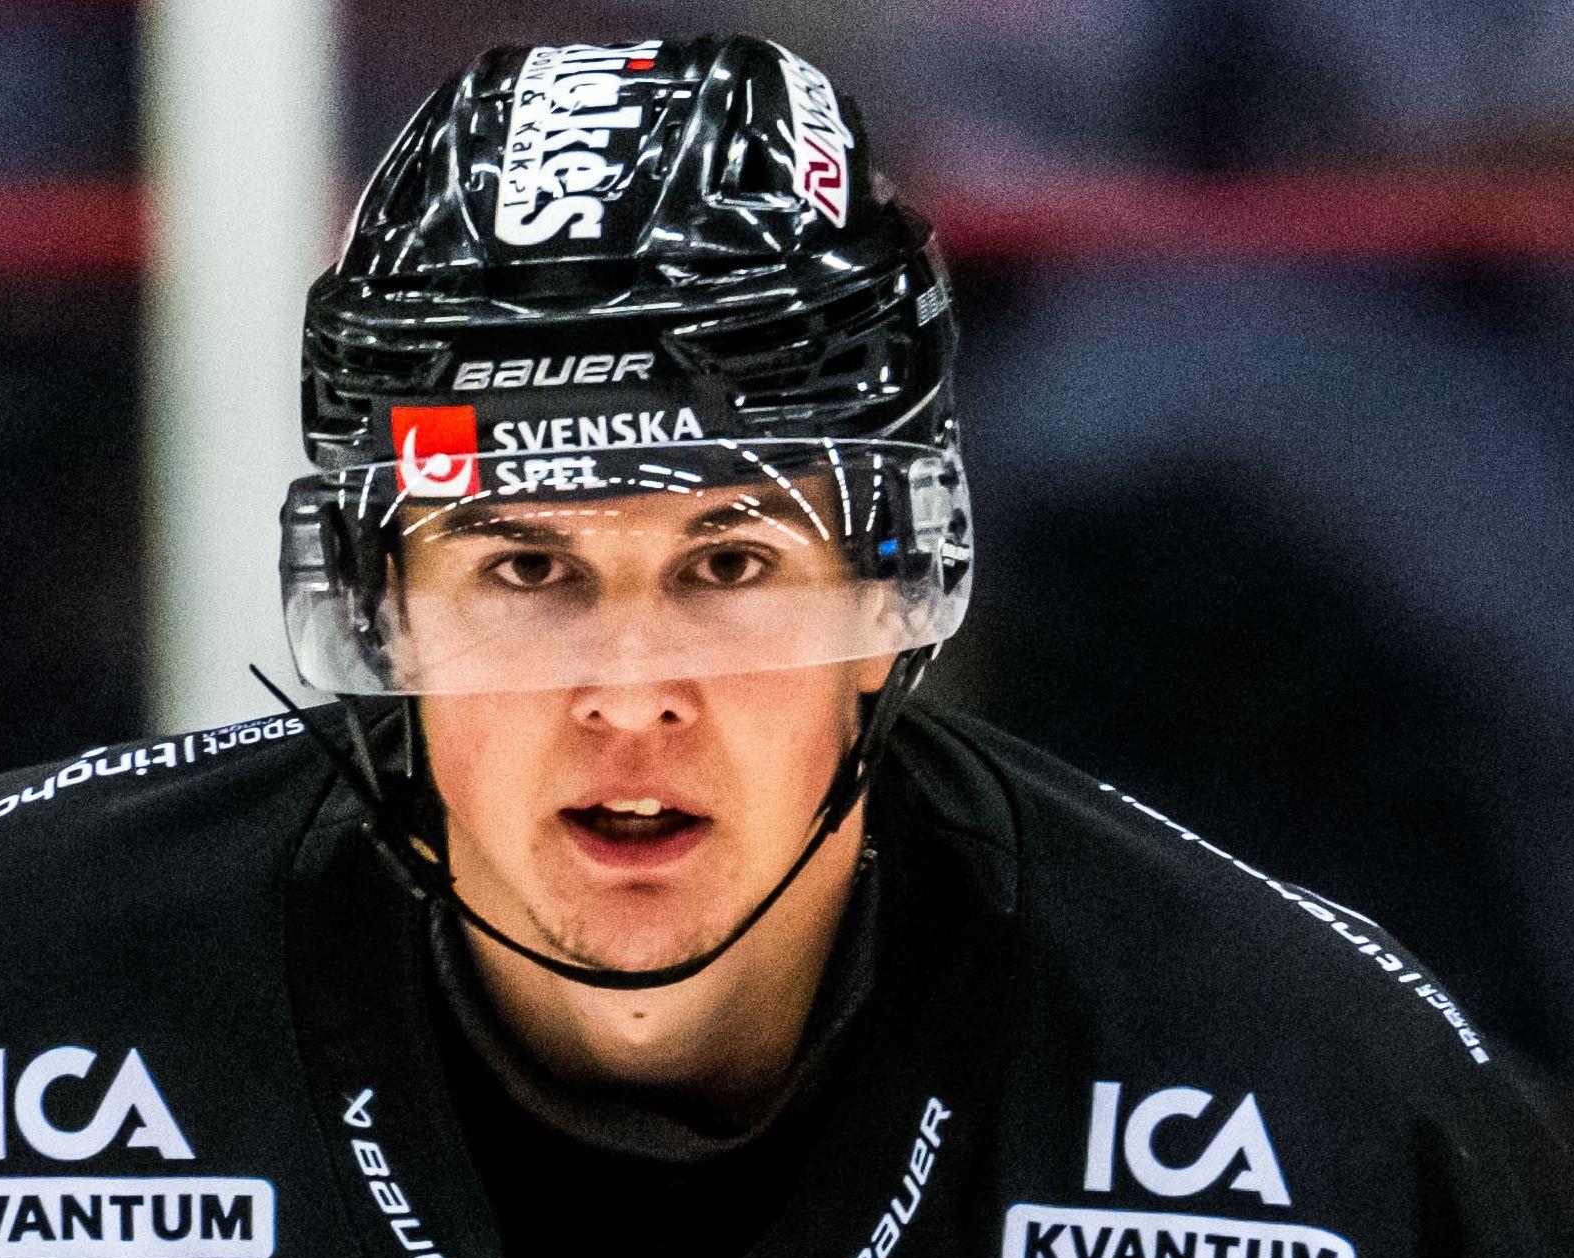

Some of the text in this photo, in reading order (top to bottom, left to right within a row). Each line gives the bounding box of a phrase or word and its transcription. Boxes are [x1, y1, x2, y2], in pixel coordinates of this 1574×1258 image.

[452, 352, 655, 391] BAUER
[492, 406, 704, 453] SVENSKA
[1083, 1080, 1292, 1206] ICA
